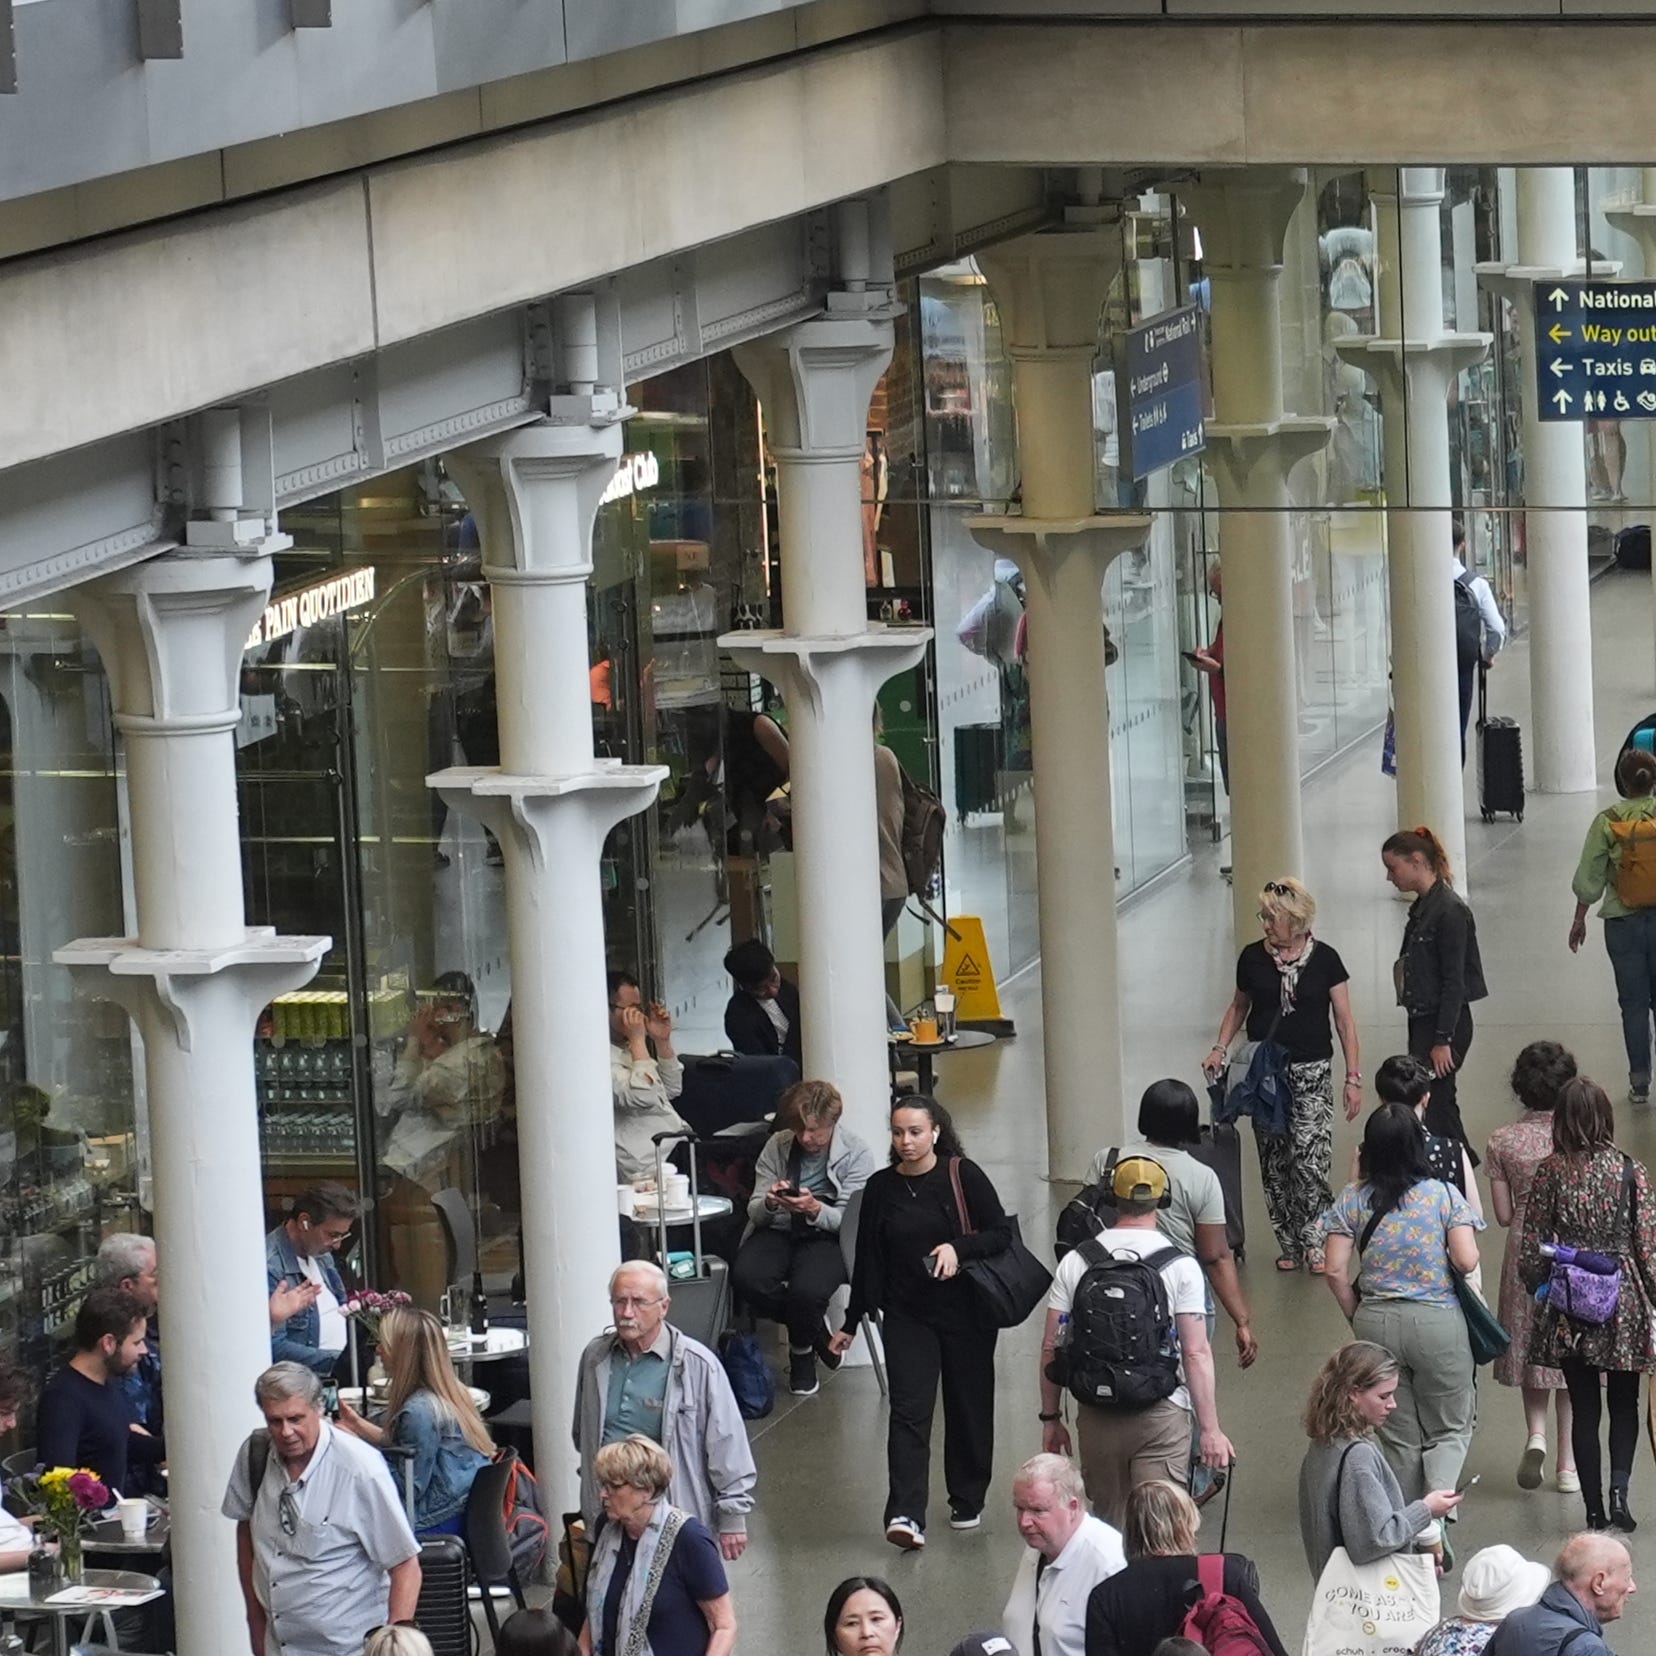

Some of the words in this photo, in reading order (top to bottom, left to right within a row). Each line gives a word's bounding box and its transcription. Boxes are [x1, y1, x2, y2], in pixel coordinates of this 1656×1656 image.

[1581, 323, 1622, 346] Way
[1582, 359, 1633, 377] Taxis
[264, 596, 299, 642] PAIN
[299, 565, 376, 628] QUOTIDIEN
[1382, 1646, 1408, 1655] croc
